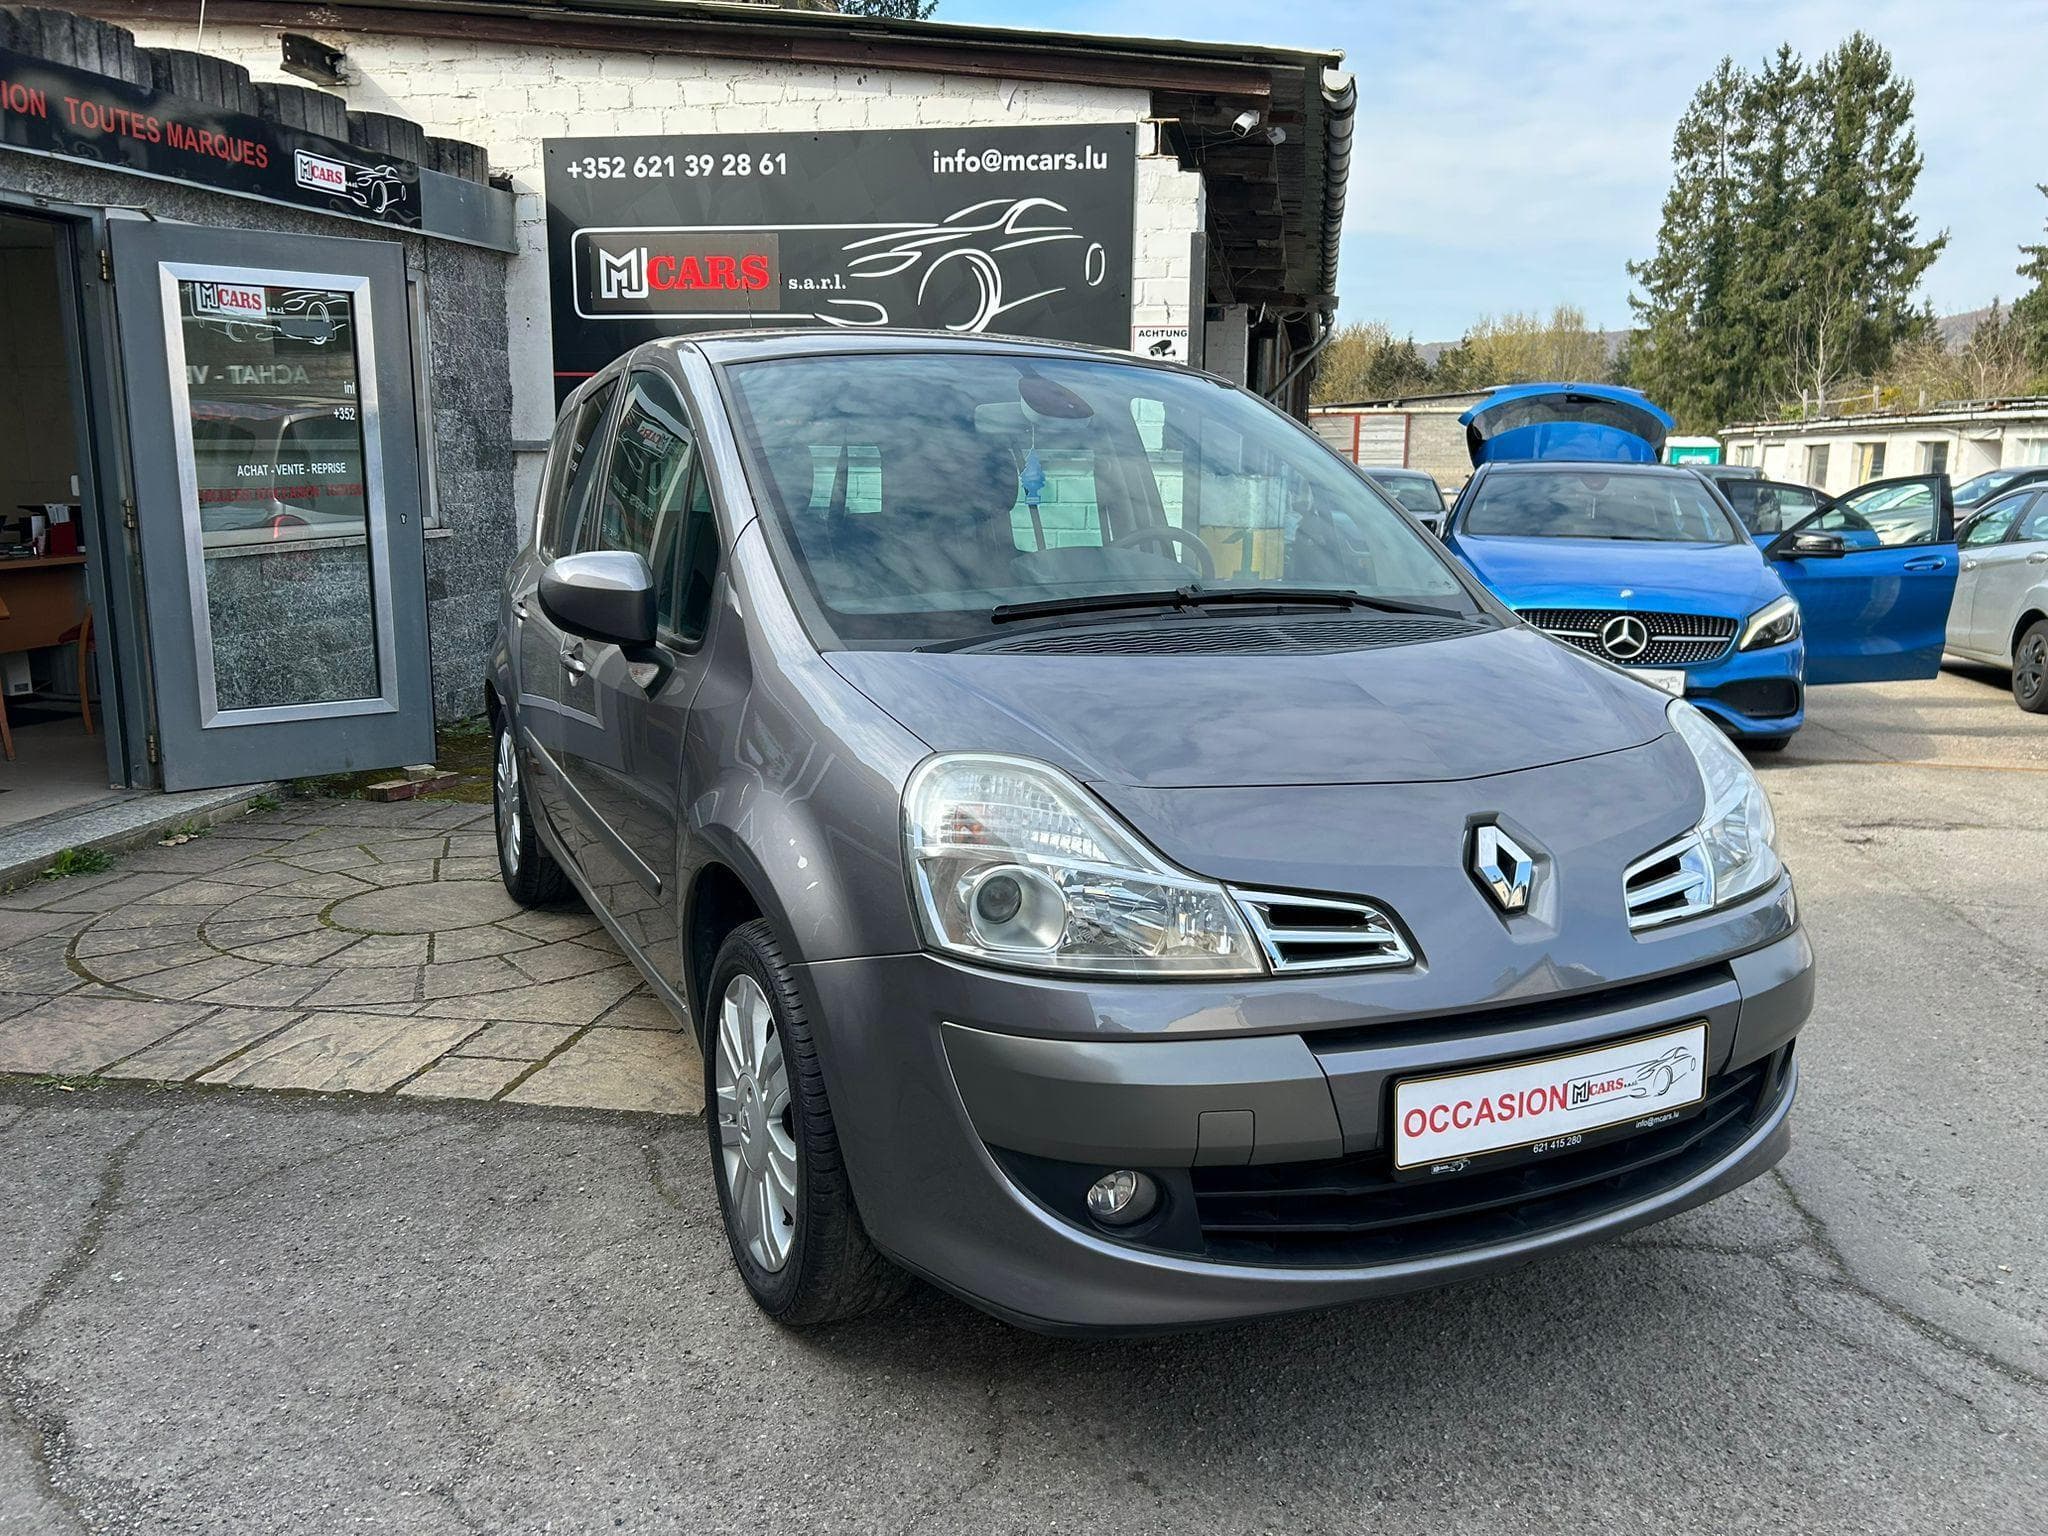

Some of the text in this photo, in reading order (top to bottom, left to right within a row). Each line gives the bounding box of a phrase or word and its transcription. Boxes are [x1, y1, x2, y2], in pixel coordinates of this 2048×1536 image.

[64, 96, 161, 143] TOUTES
[166, 121, 269, 168] MARQUES
[567, 152, 787, 179] +352 621 39 28 61
[933, 145, 1107, 173] info@mcars.lu
[788, 273, 847, 290] s.a.r.l.
[1138, 329, 1188, 338] ACHTUNG
[333, 407, 356, 421] +352
[237, 464, 269, 477] ACHAT
[275, 463, 305, 476] VENTE
[312, 462, 347, 475] REPRISE
[1403, 1083, 1568, 1138] OCCASION
[1635, 1111, 1680, 1129] info@mcars.lu
[1533, 1135, 1582, 1153] 621 415 280
